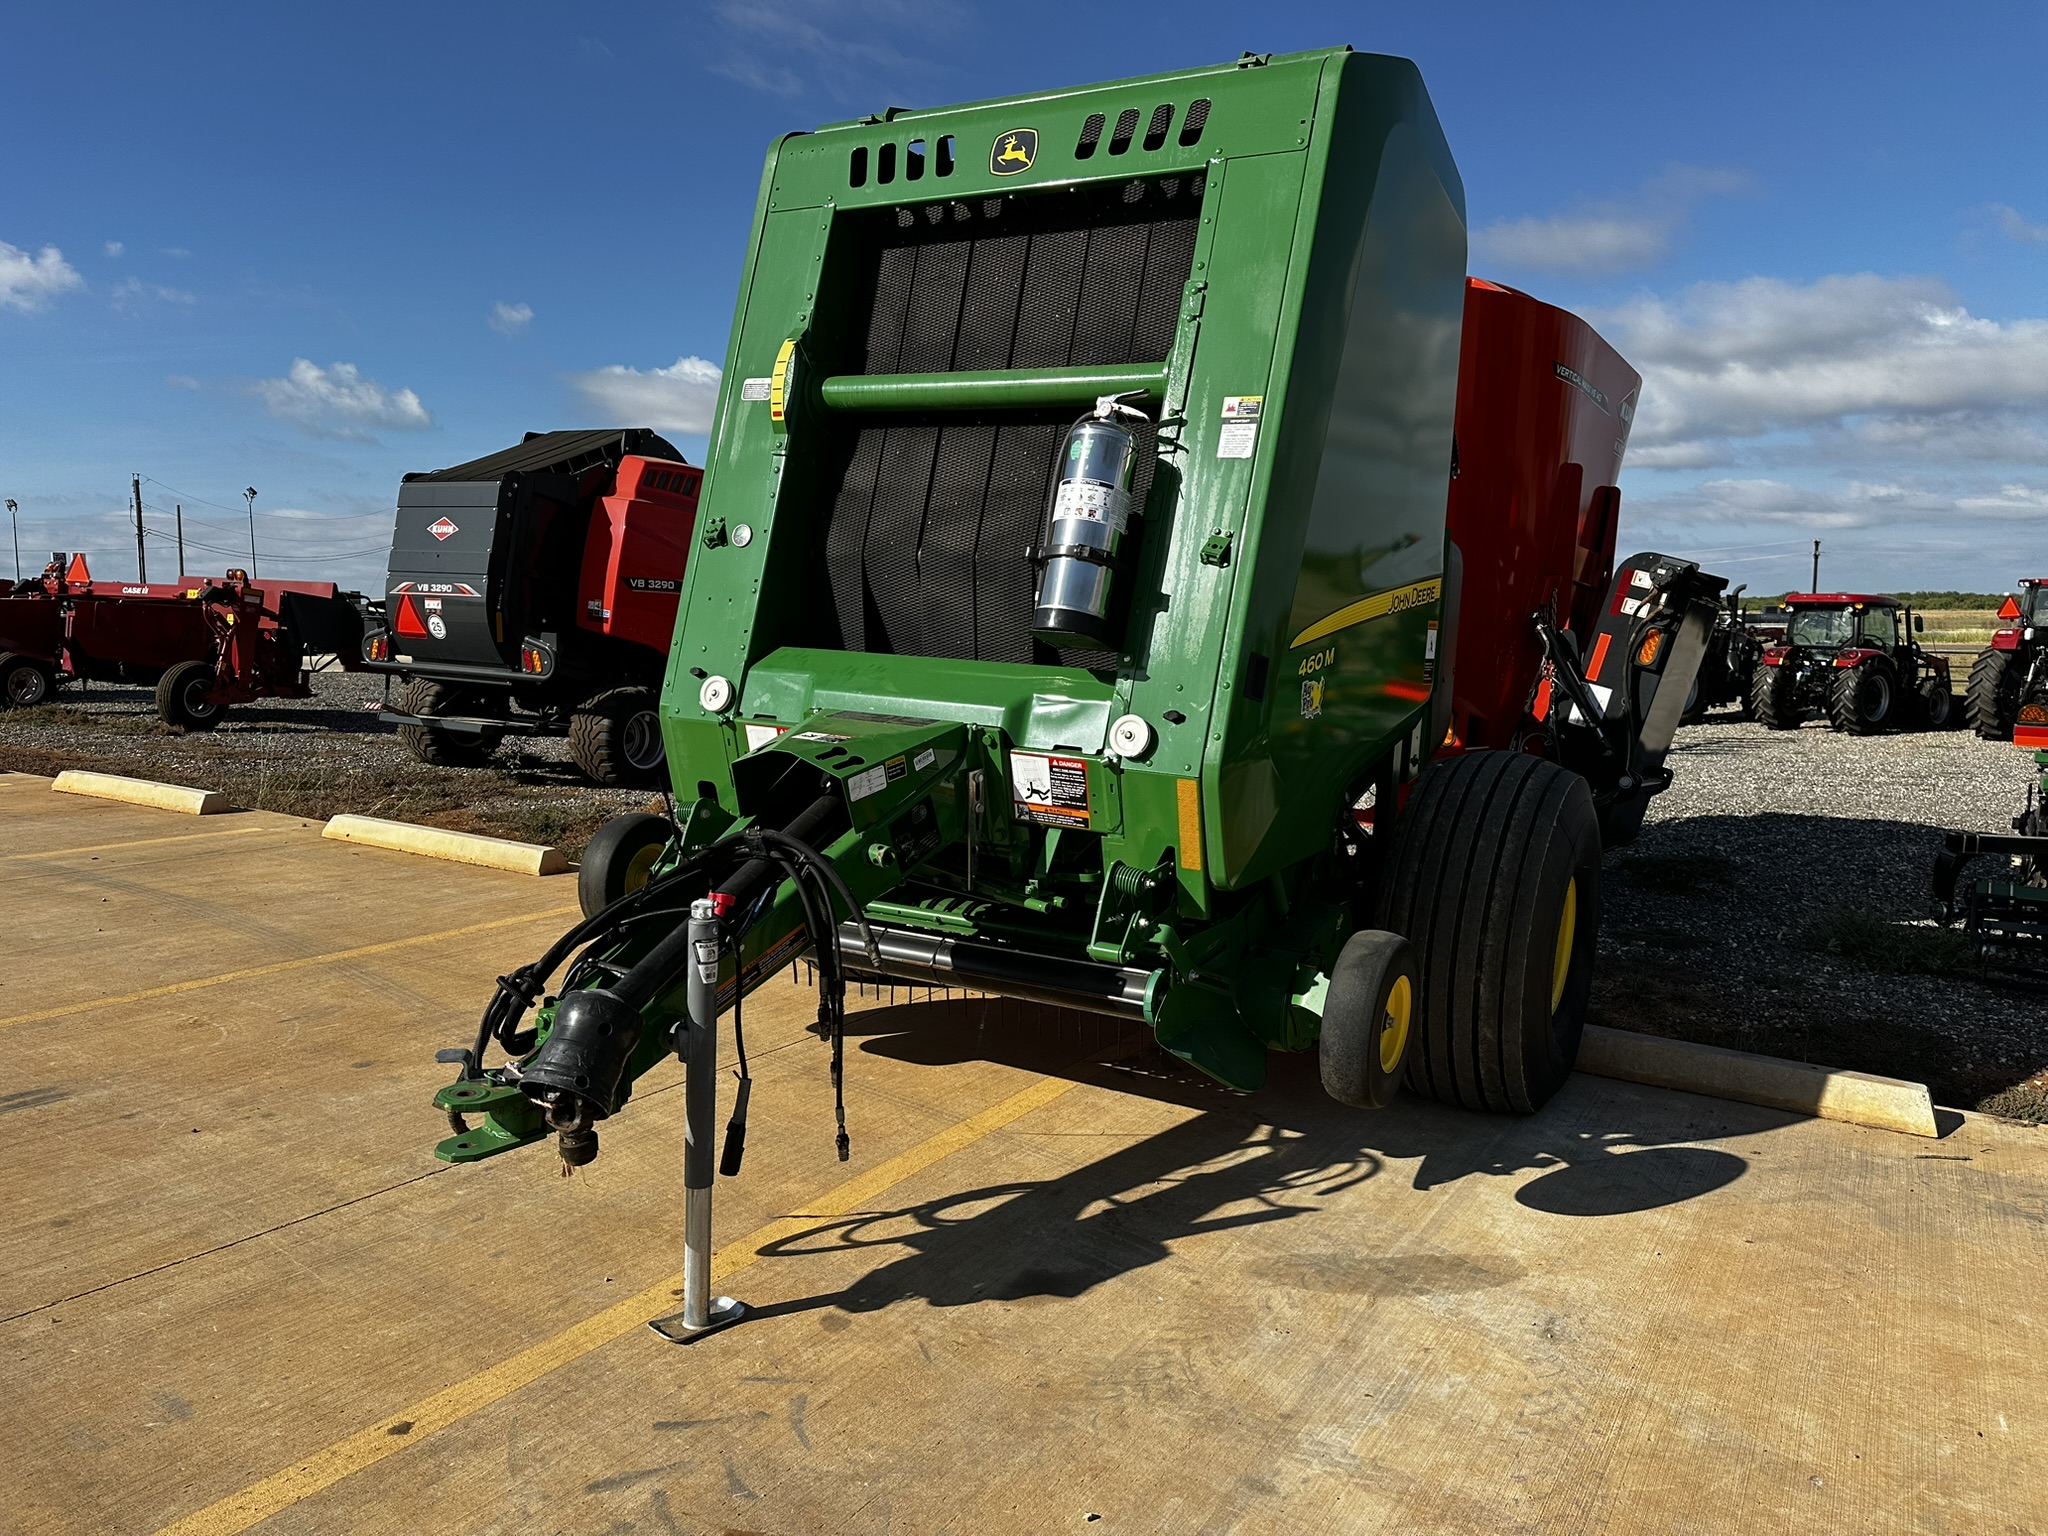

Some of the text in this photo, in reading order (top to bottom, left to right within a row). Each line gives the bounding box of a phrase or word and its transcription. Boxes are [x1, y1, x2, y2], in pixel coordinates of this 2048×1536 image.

[1556, 364, 1582, 386] VERTICAL
[432, 525, 454, 534] KUHN
[417, 583, 453, 592] VB 3290
[629, 578, 675, 589] VB 3290
[122, 586, 142, 594] CASE
[1387, 586, 1436, 615] JOHN DEERE
[431, 621, 443, 632] 25
[1058, 760, 1083, 769] DANGER
